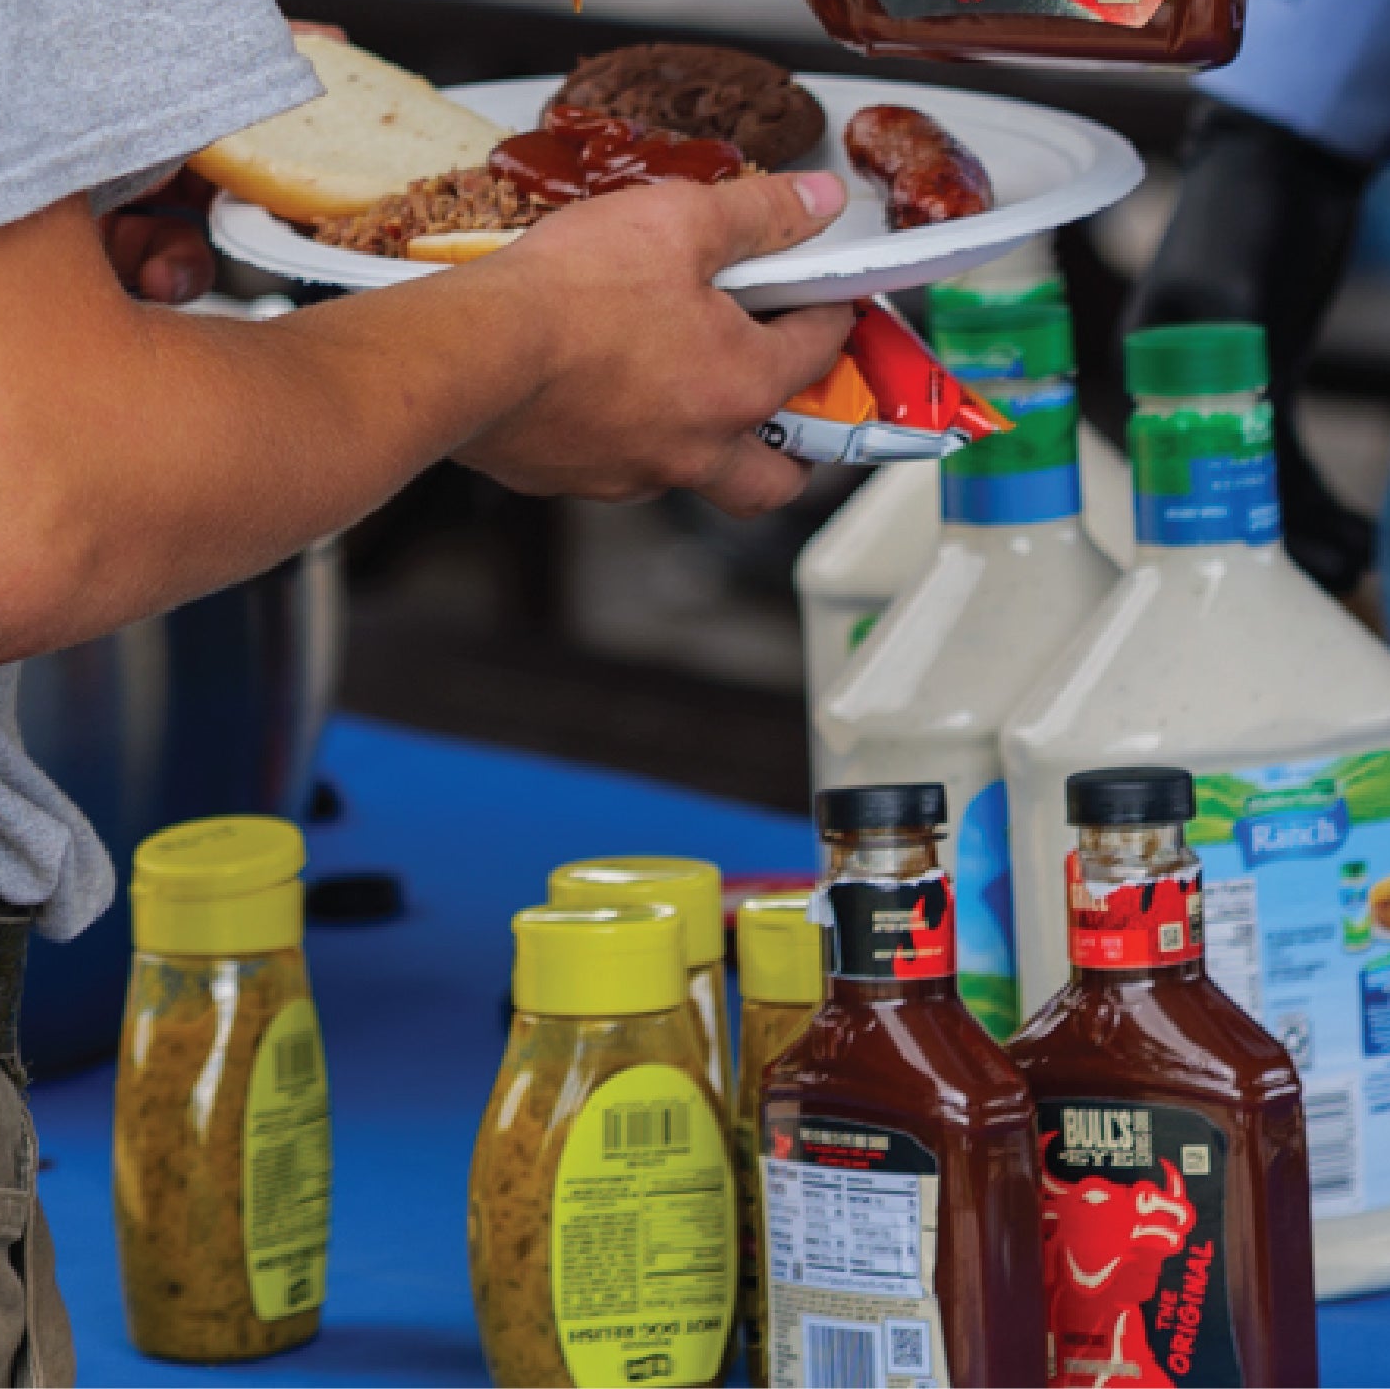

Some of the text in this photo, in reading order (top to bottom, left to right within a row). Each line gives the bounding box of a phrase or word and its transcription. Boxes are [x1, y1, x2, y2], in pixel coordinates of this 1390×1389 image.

[1251, 816, 1336, 853] Ranch
[1155, 1289, 1179, 1330] THE
[1167, 1239, 1215, 1375] ORIGINAL
